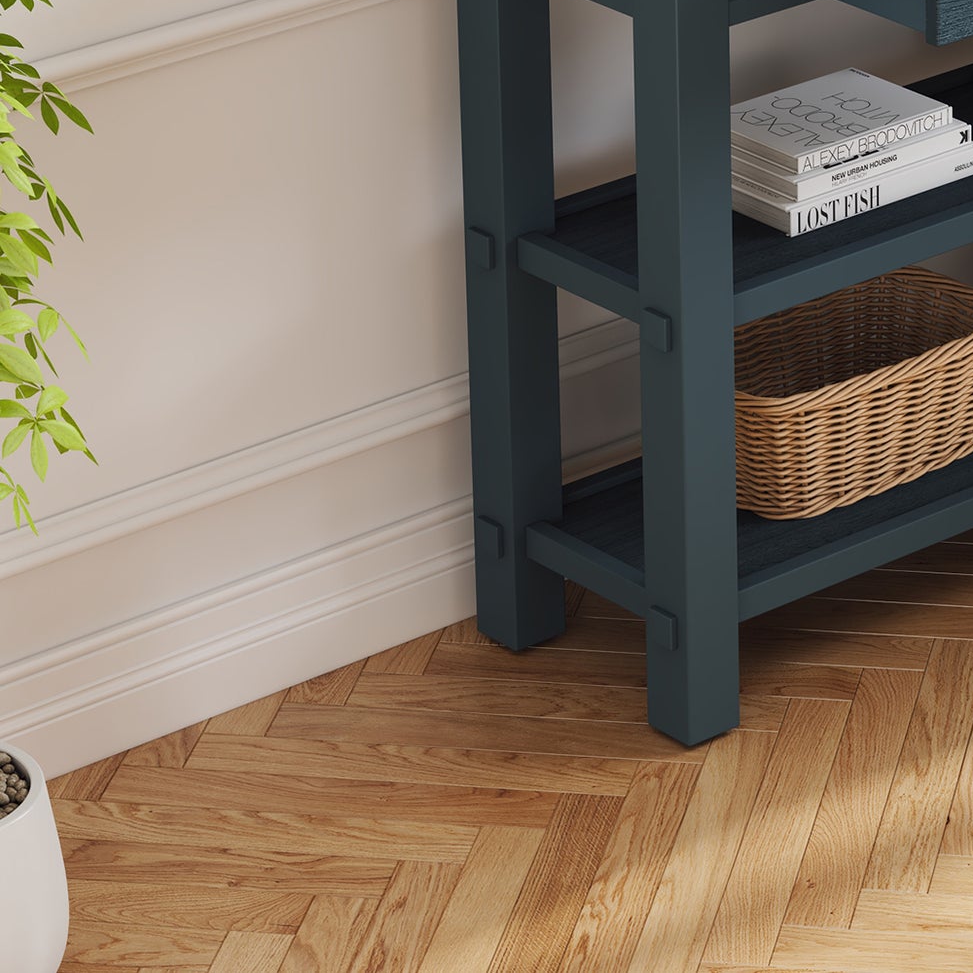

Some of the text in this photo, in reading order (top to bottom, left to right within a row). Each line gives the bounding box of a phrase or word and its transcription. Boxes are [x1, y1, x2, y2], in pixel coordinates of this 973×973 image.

[731, 108, 834, 147] ALEXEY
[821, 91, 901, 125] VITCH
[803, 141, 854, 172] ALEXEY
[858, 112, 943, 155] BRODOVITCH
[831, 172, 846, 182] NEW
[846, 163, 869, 178] URBAN
[869, 154, 898, 170] HOUSING
[797, 185, 881, 235] LOST FISH
